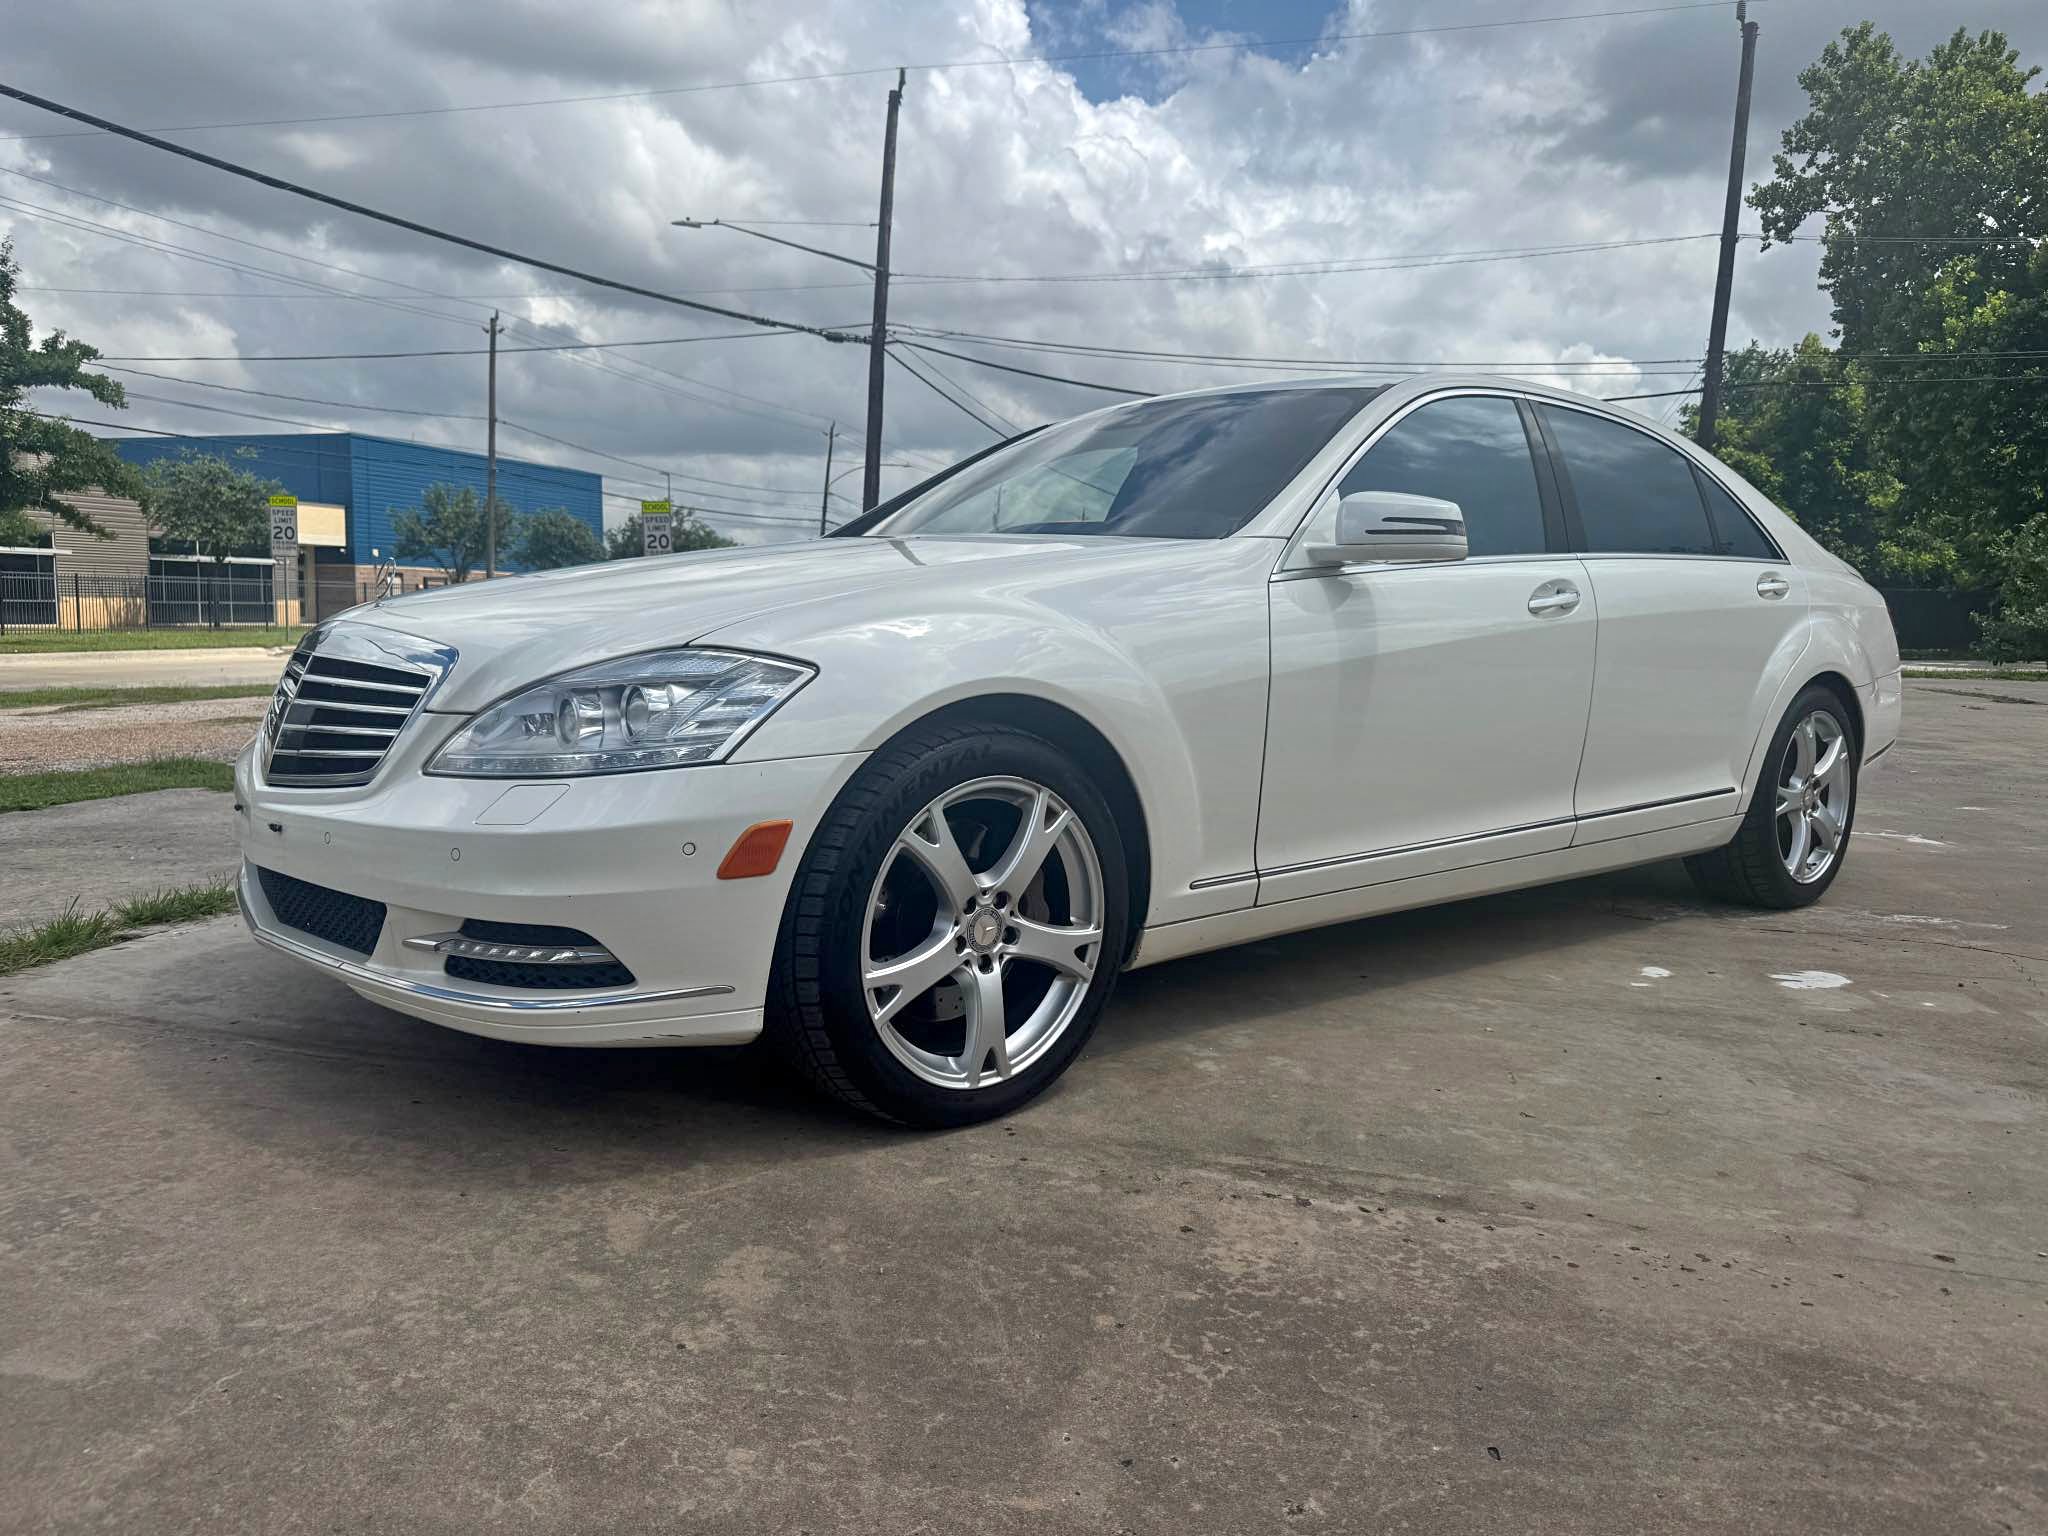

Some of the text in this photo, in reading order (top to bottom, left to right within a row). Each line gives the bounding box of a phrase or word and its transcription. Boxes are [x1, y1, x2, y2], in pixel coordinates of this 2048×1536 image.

[271, 497, 295, 505] SCHOOL
[643, 503, 668, 511] SCHOOL
[273, 526, 295, 539] 20
[647, 534, 669, 549] 20
